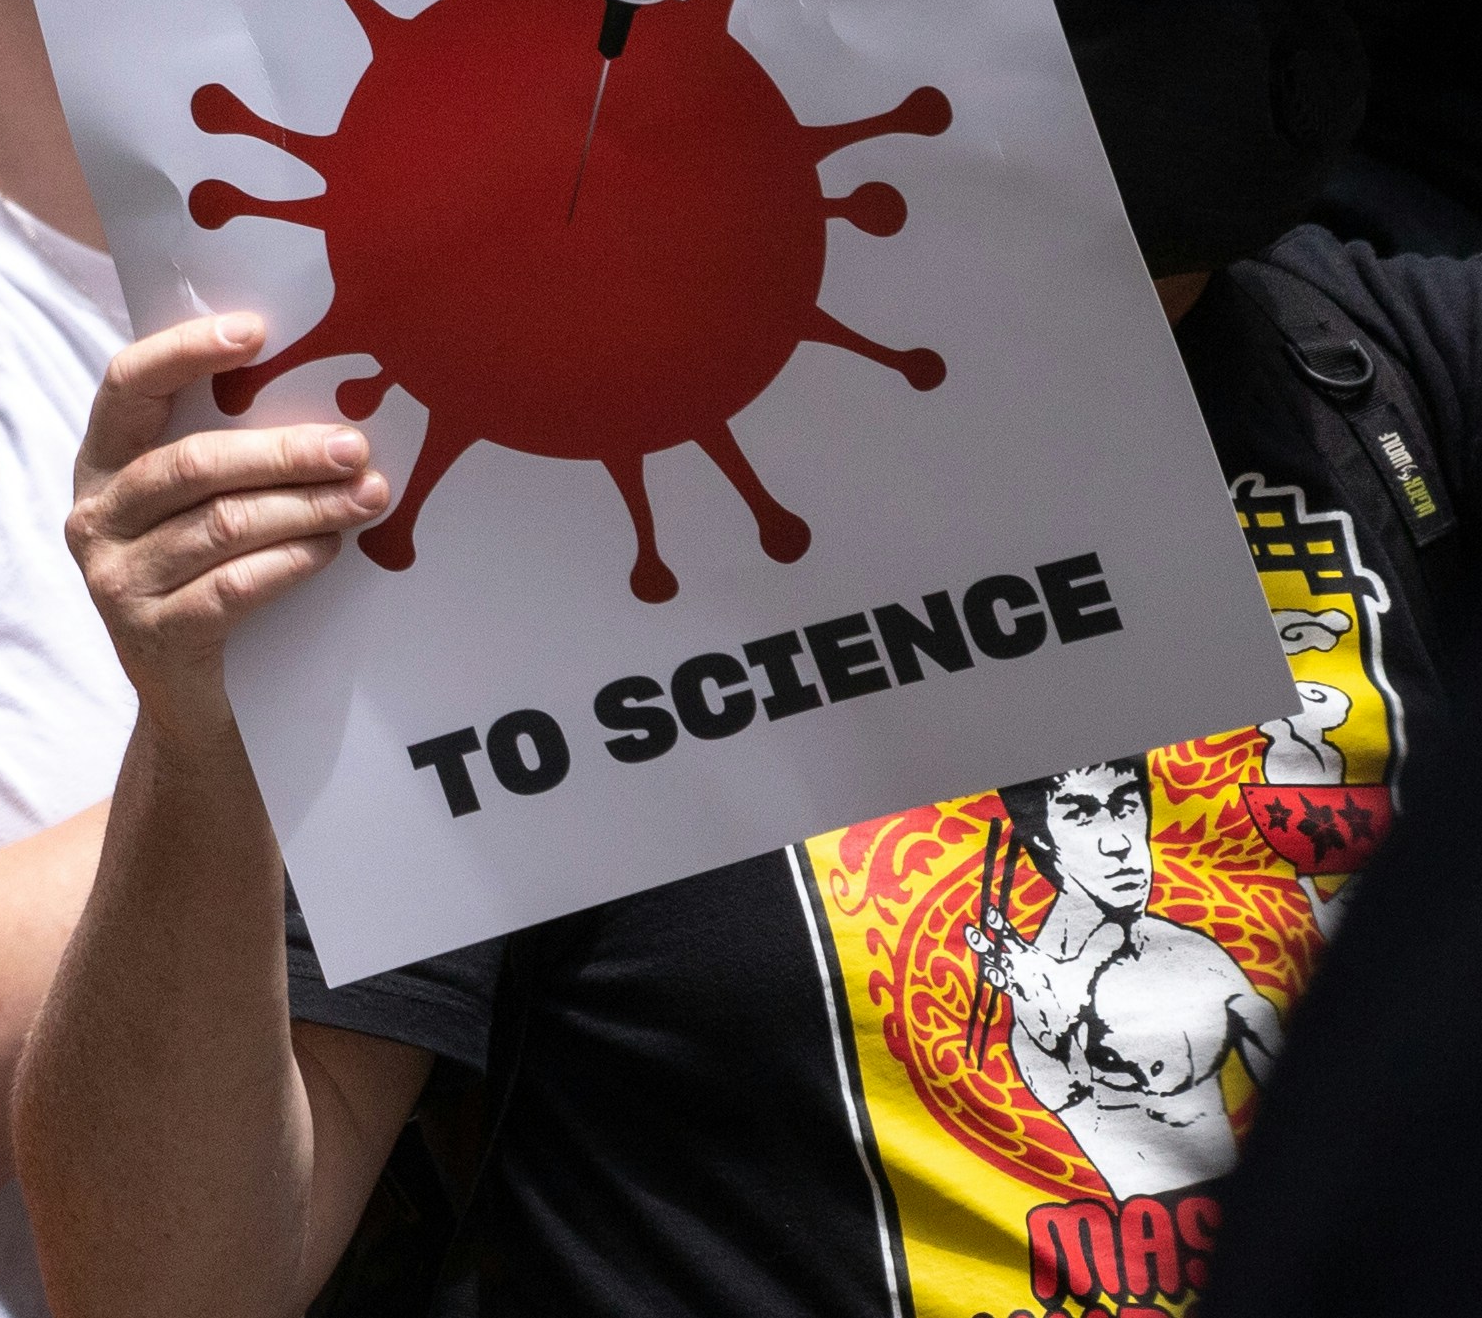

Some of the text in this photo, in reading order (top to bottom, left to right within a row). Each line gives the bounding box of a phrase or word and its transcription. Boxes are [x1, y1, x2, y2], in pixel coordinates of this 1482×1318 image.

[407, 550, 1125, 818] TO SCIENCE
[1026, 1196, 1222, 1280] MAS
